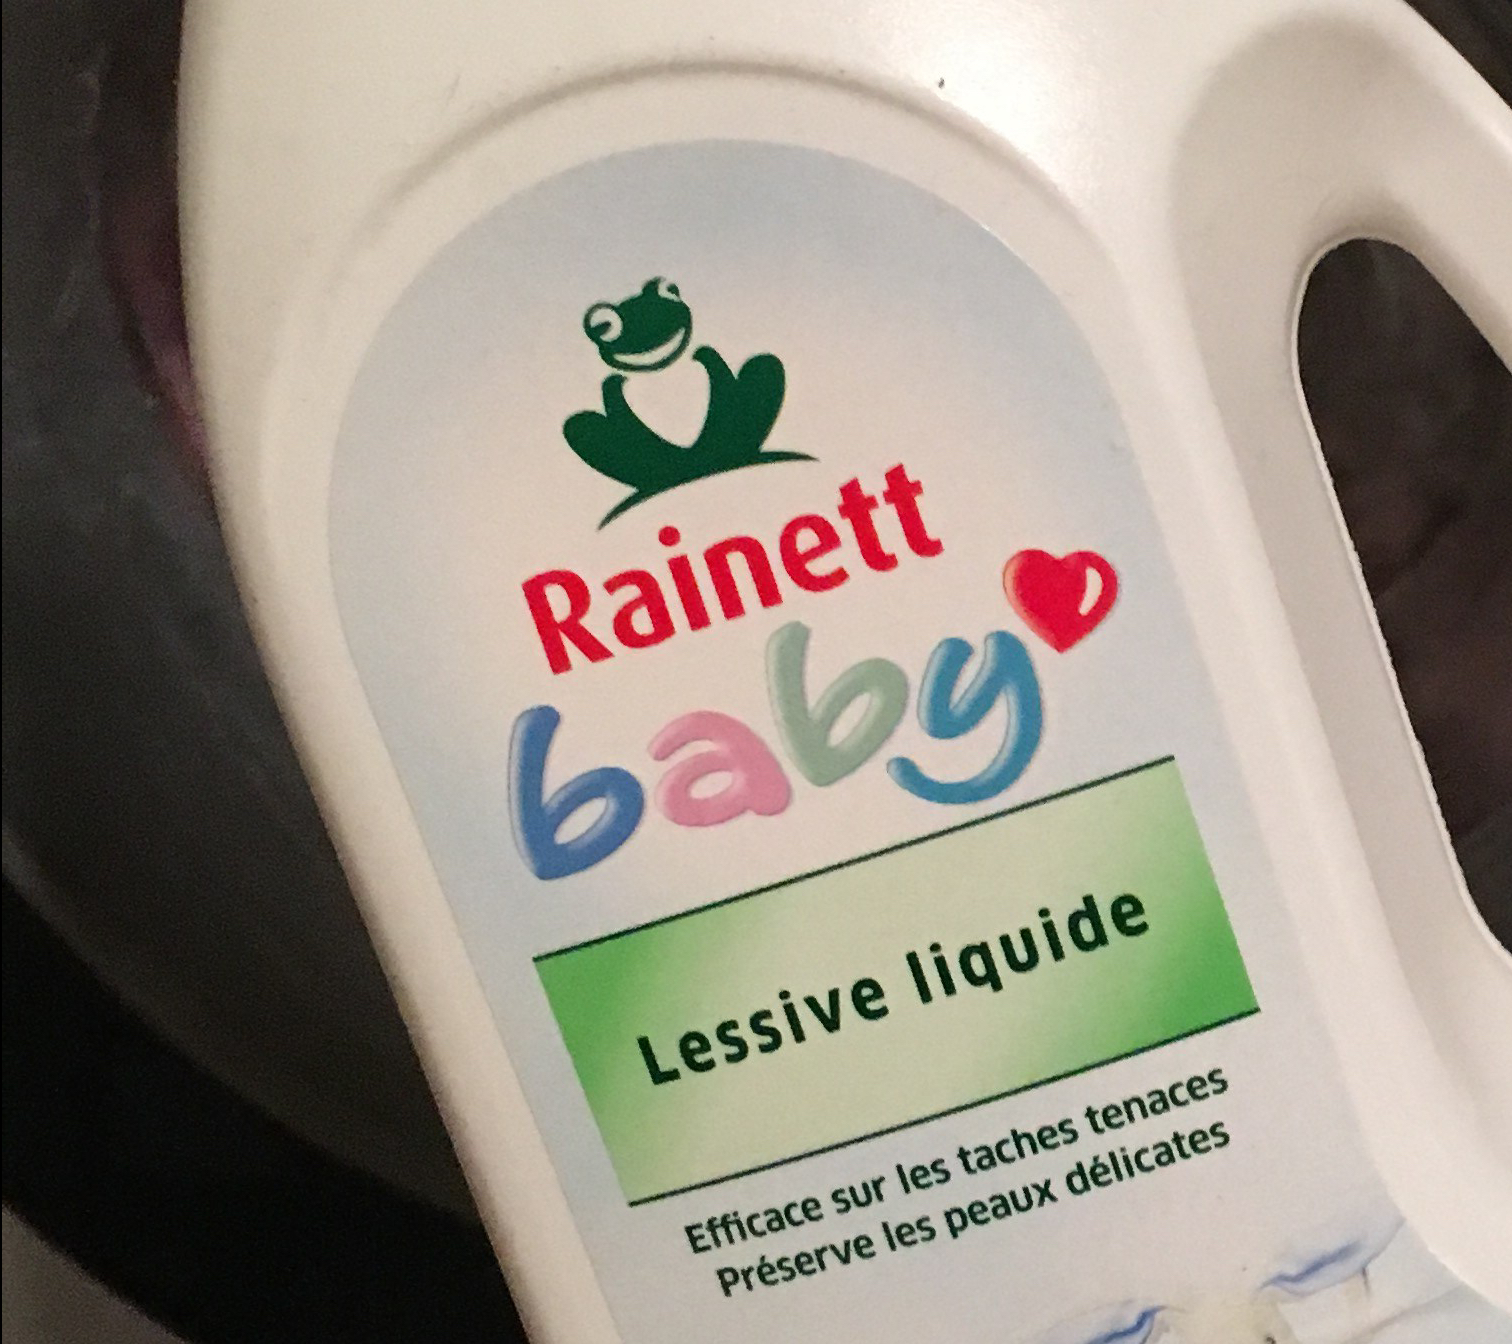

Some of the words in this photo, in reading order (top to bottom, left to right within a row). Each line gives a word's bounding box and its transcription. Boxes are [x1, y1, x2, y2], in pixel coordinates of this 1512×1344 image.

[522, 463, 944, 675] Rainett
[508, 621, 1043, 881] baby
[636, 976, 889, 1086] Lessive
[906, 892, 1150, 1004] liquide
[684, 1197, 824, 1254] Efficace
[830, 1176, 886, 1216] sur
[898, 1158, 951, 1196] les
[957, 1115, 1078, 1177] taches
[1085, 1065, 1229, 1136] tenaces
[715, 1236, 877, 1297] Préserve
[881, 1214, 937, 1254] les
[944, 1176, 1057, 1239] peaux
[1066, 1118, 1231, 1197] délicates
